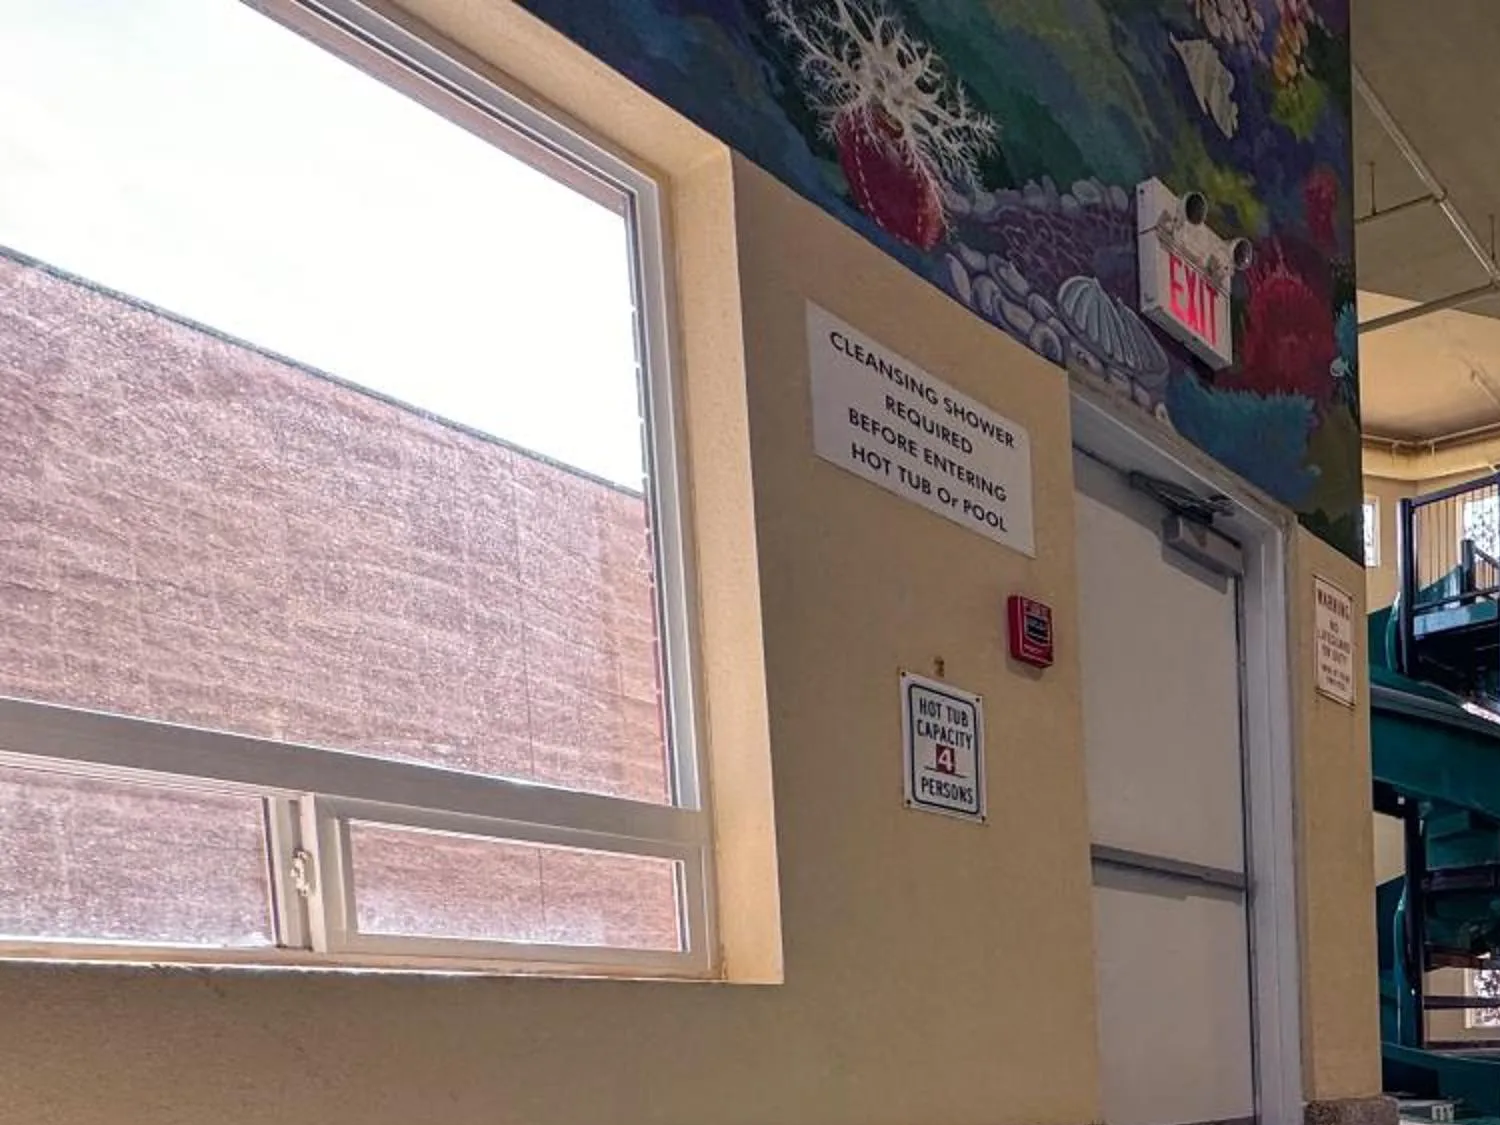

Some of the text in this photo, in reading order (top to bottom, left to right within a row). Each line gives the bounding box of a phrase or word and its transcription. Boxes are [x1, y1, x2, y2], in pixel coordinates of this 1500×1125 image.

[1169, 253, 1218, 346] EXIT
[829, 331, 1015, 449] CLEANSING SHOWER
[885, 395, 973, 454] REQUIRED
[848, 408, 1007, 502] BEFORE ENTERING
[851, 443, 1008, 533] HOT TUB Or POOL
[917, 719, 973, 749] CAPACITY
[919, 696, 969, 727] HOT TUB
[938, 749, 954, 771] 4
[921, 776, 974, 805] PERSONS
